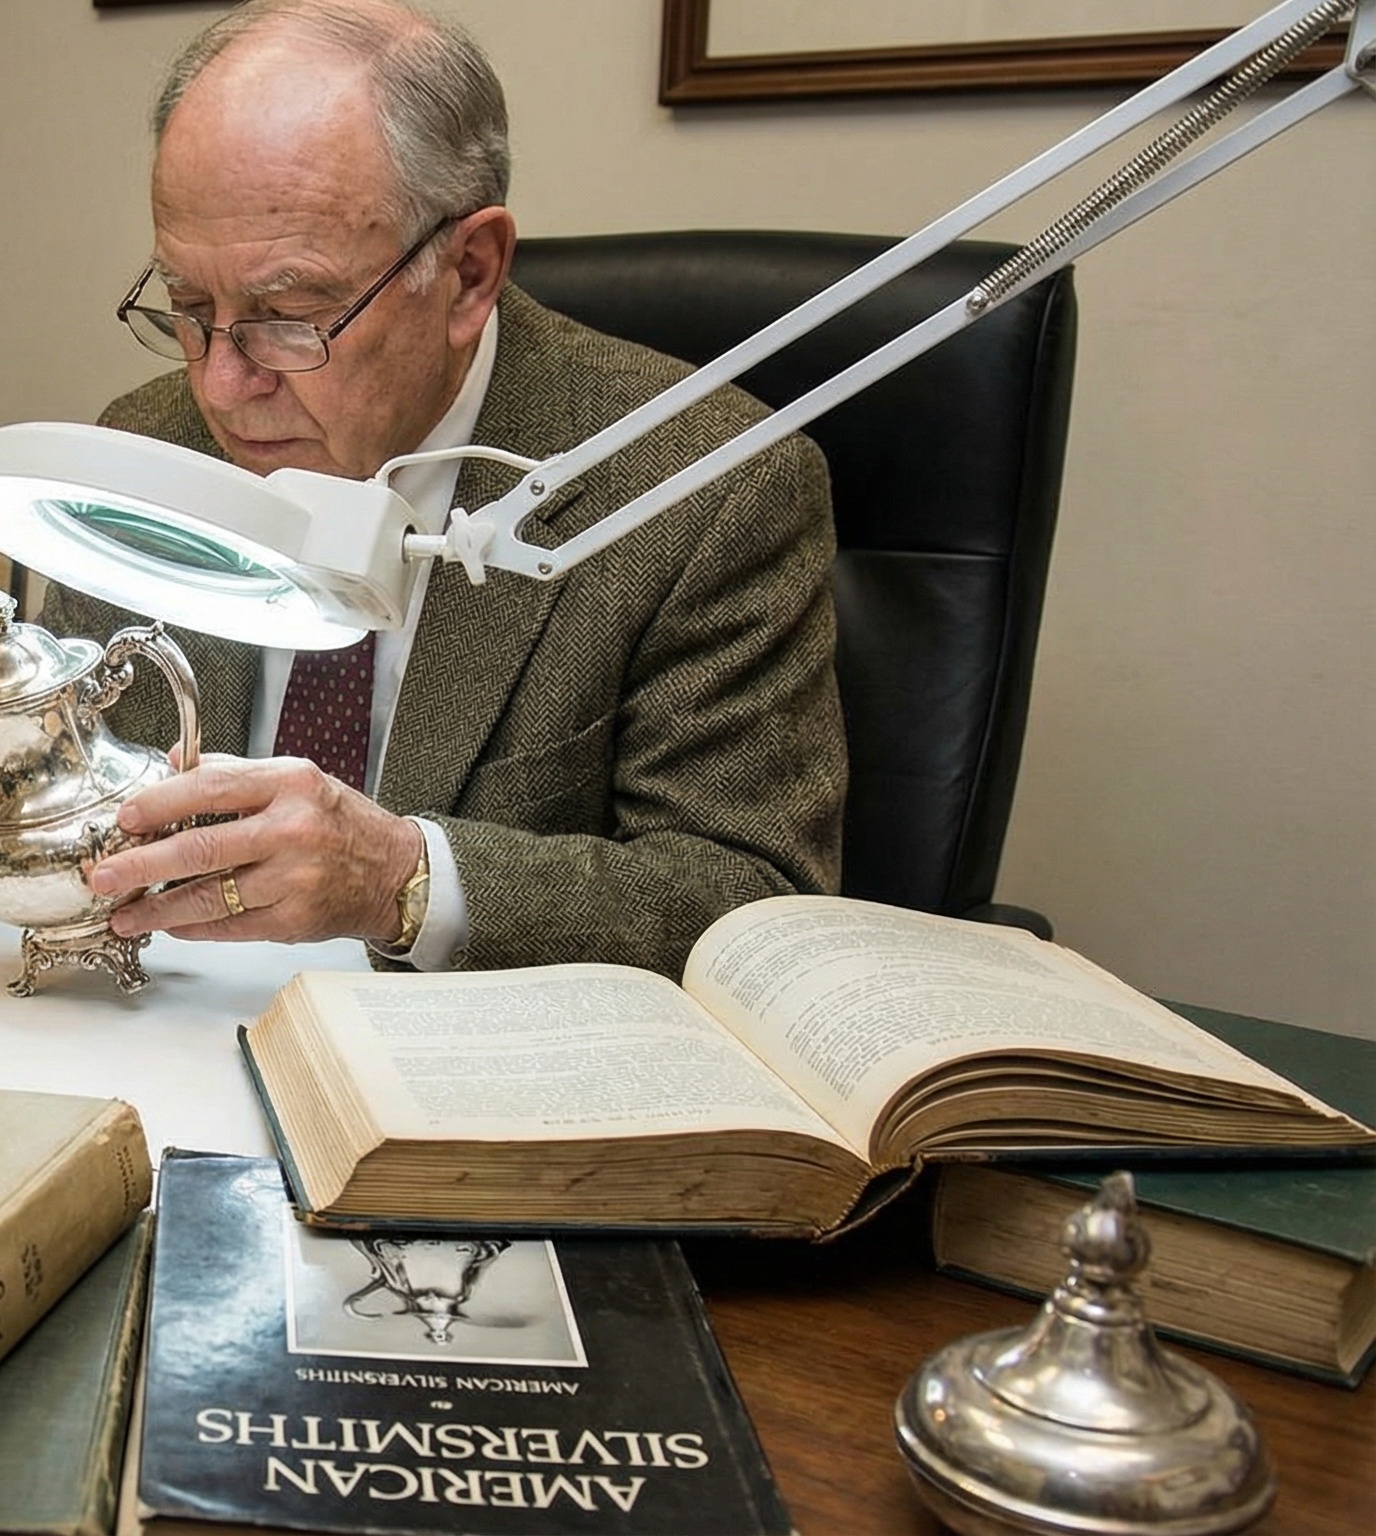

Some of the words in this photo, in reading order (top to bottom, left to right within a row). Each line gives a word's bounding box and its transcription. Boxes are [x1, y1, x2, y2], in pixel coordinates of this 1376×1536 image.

[455, 1376, 580, 1396] AMERICAN
[195, 1407, 711, 1469] SILVERSMITHS
[263, 1456, 646, 1513] AMERICAN
